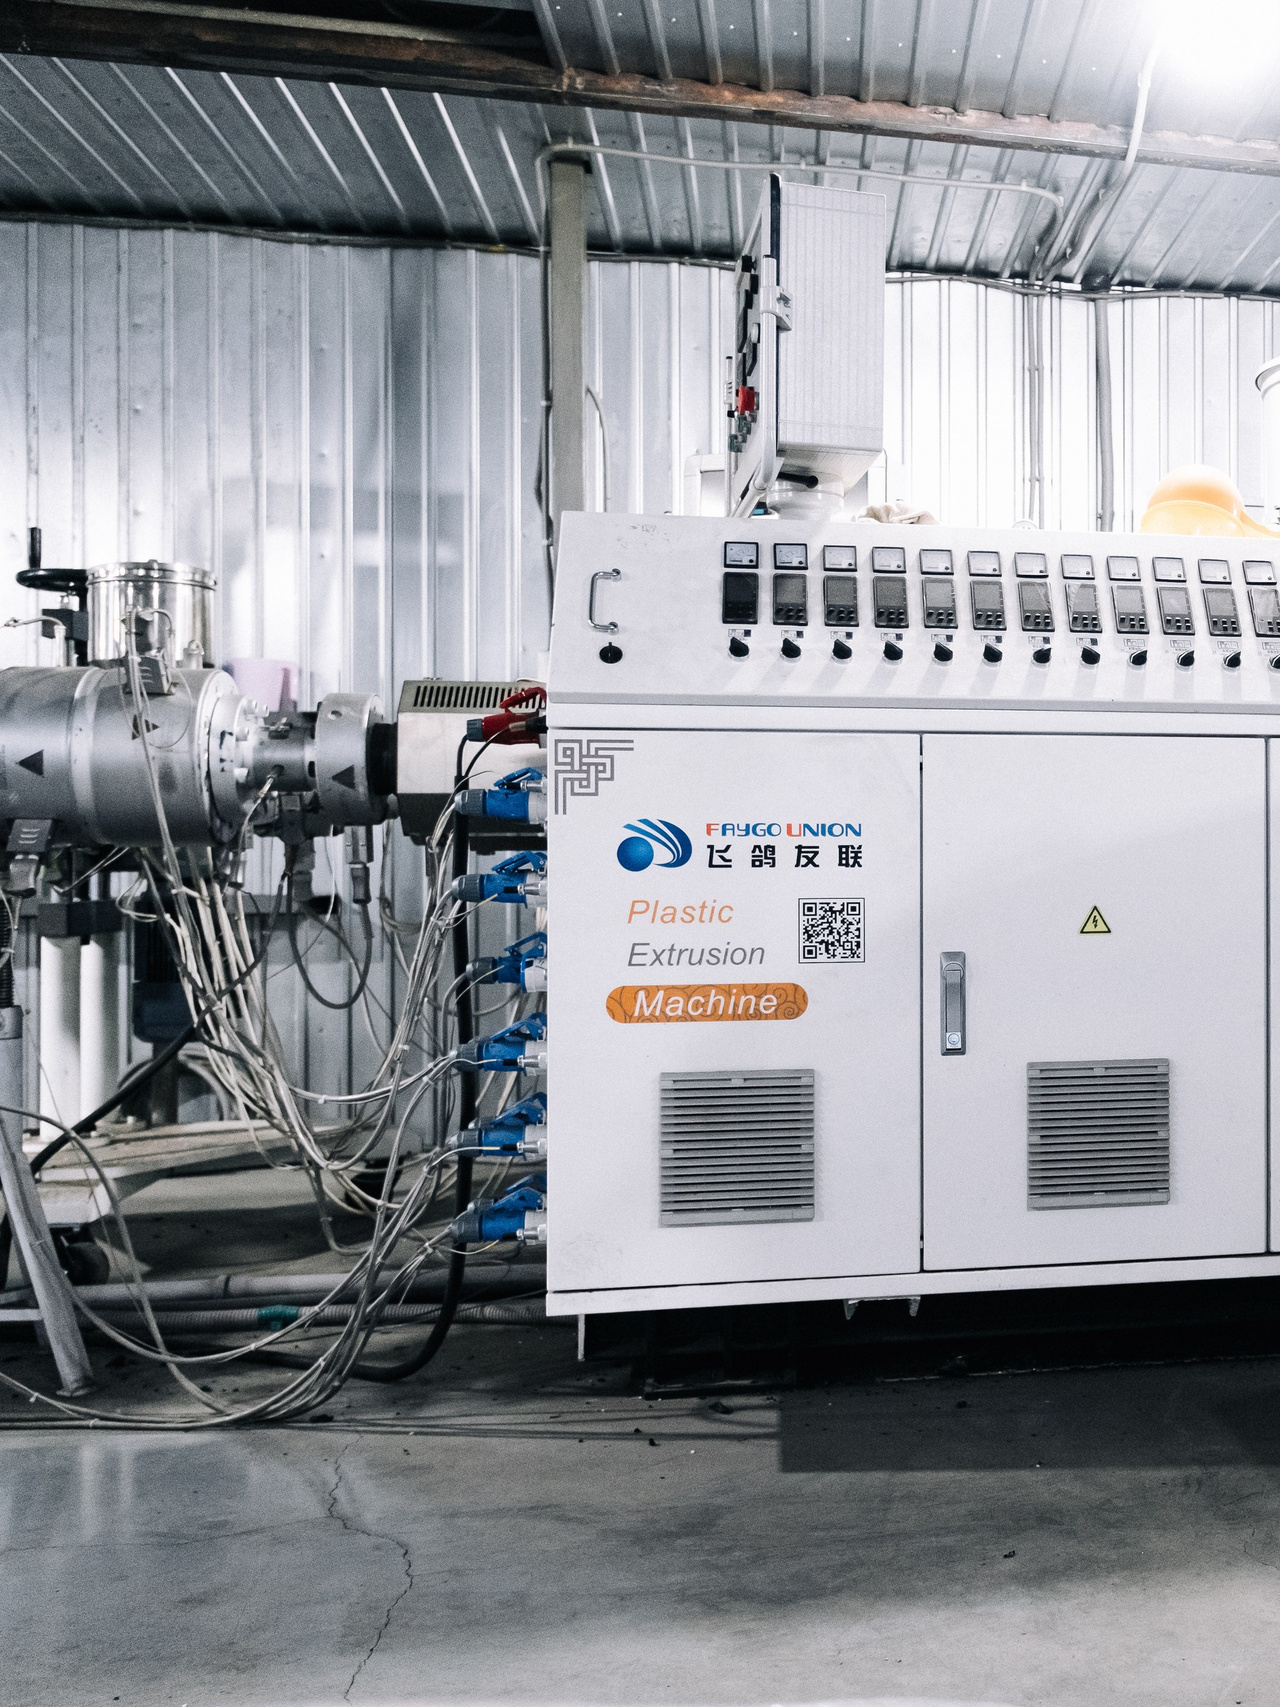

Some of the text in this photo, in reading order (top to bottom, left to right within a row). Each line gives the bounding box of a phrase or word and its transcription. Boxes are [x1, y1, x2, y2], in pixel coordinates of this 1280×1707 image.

[706, 823, 862, 838] FAYGO UNION
[707, 844, 863, 869] 飞鸽友联
[628, 900, 734, 924] Plastic
[628, 942, 765, 967] Extrusion
[633, 989, 778, 1017] Machine
